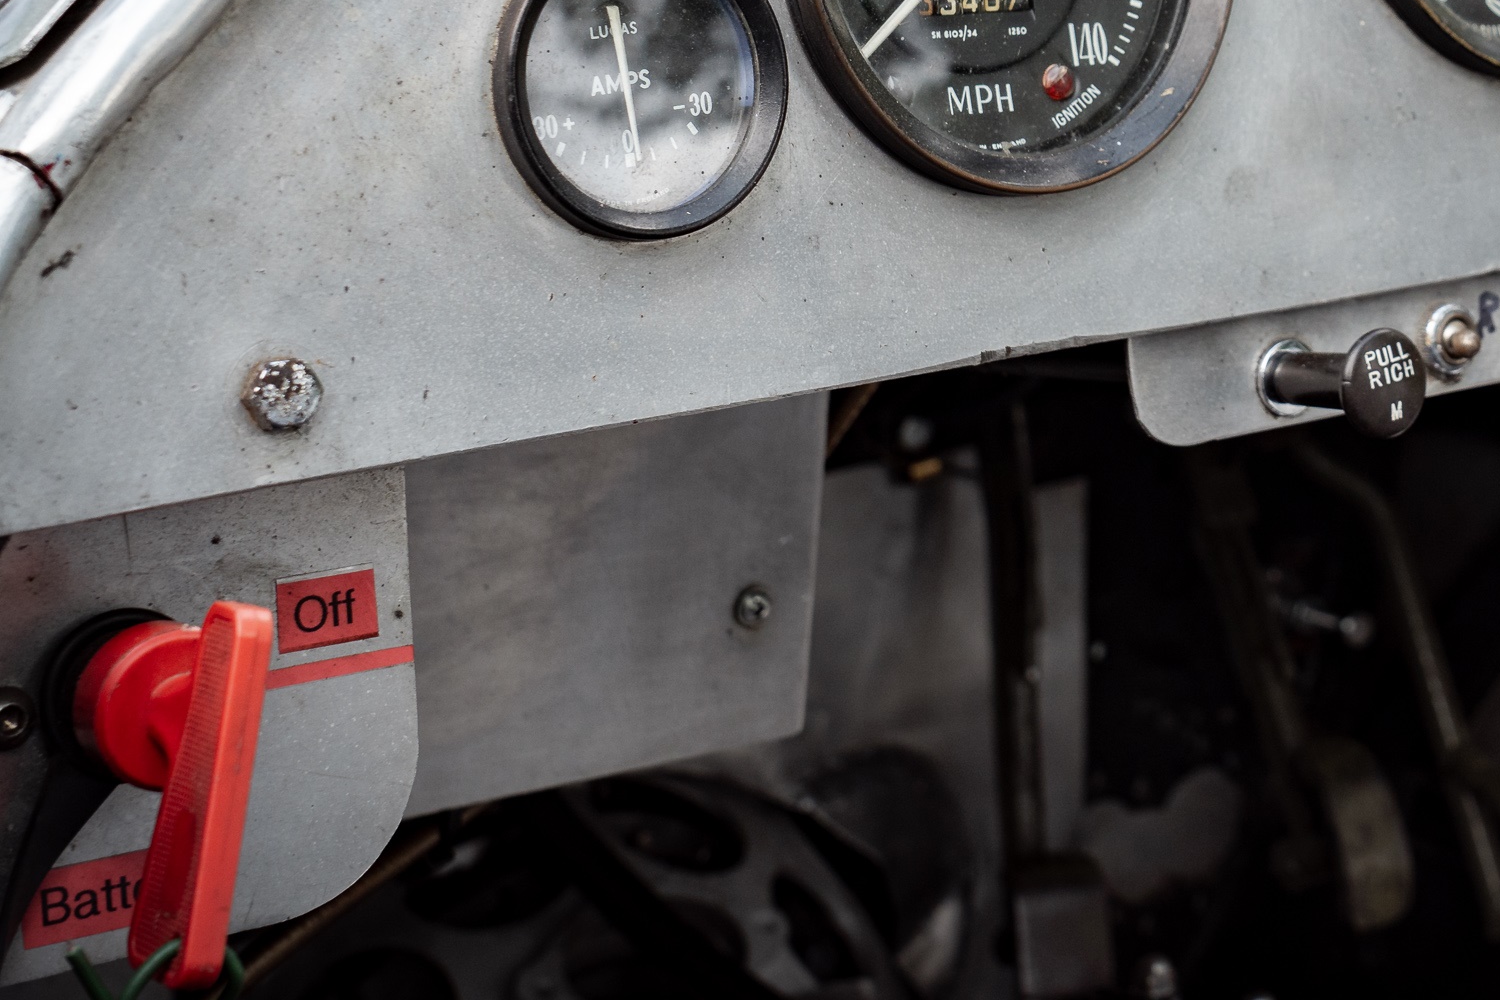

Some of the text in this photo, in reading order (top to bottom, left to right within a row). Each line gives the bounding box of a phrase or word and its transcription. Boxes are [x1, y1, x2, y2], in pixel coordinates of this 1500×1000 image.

[1068, 22, 1108, 67] 140
[591, 69, 651, 97] AMPS
[947, 83, 1015, 115] MPH
[1051, 84, 1102, 129] IGNITION
[622, 129, 634, 153] 0
[1364, 341, 1410, 370] PULL
[1368, 359, 1415, 389] RICH
[1391, 400, 1403, 421] M
[294, 588, 356, 632] Off
